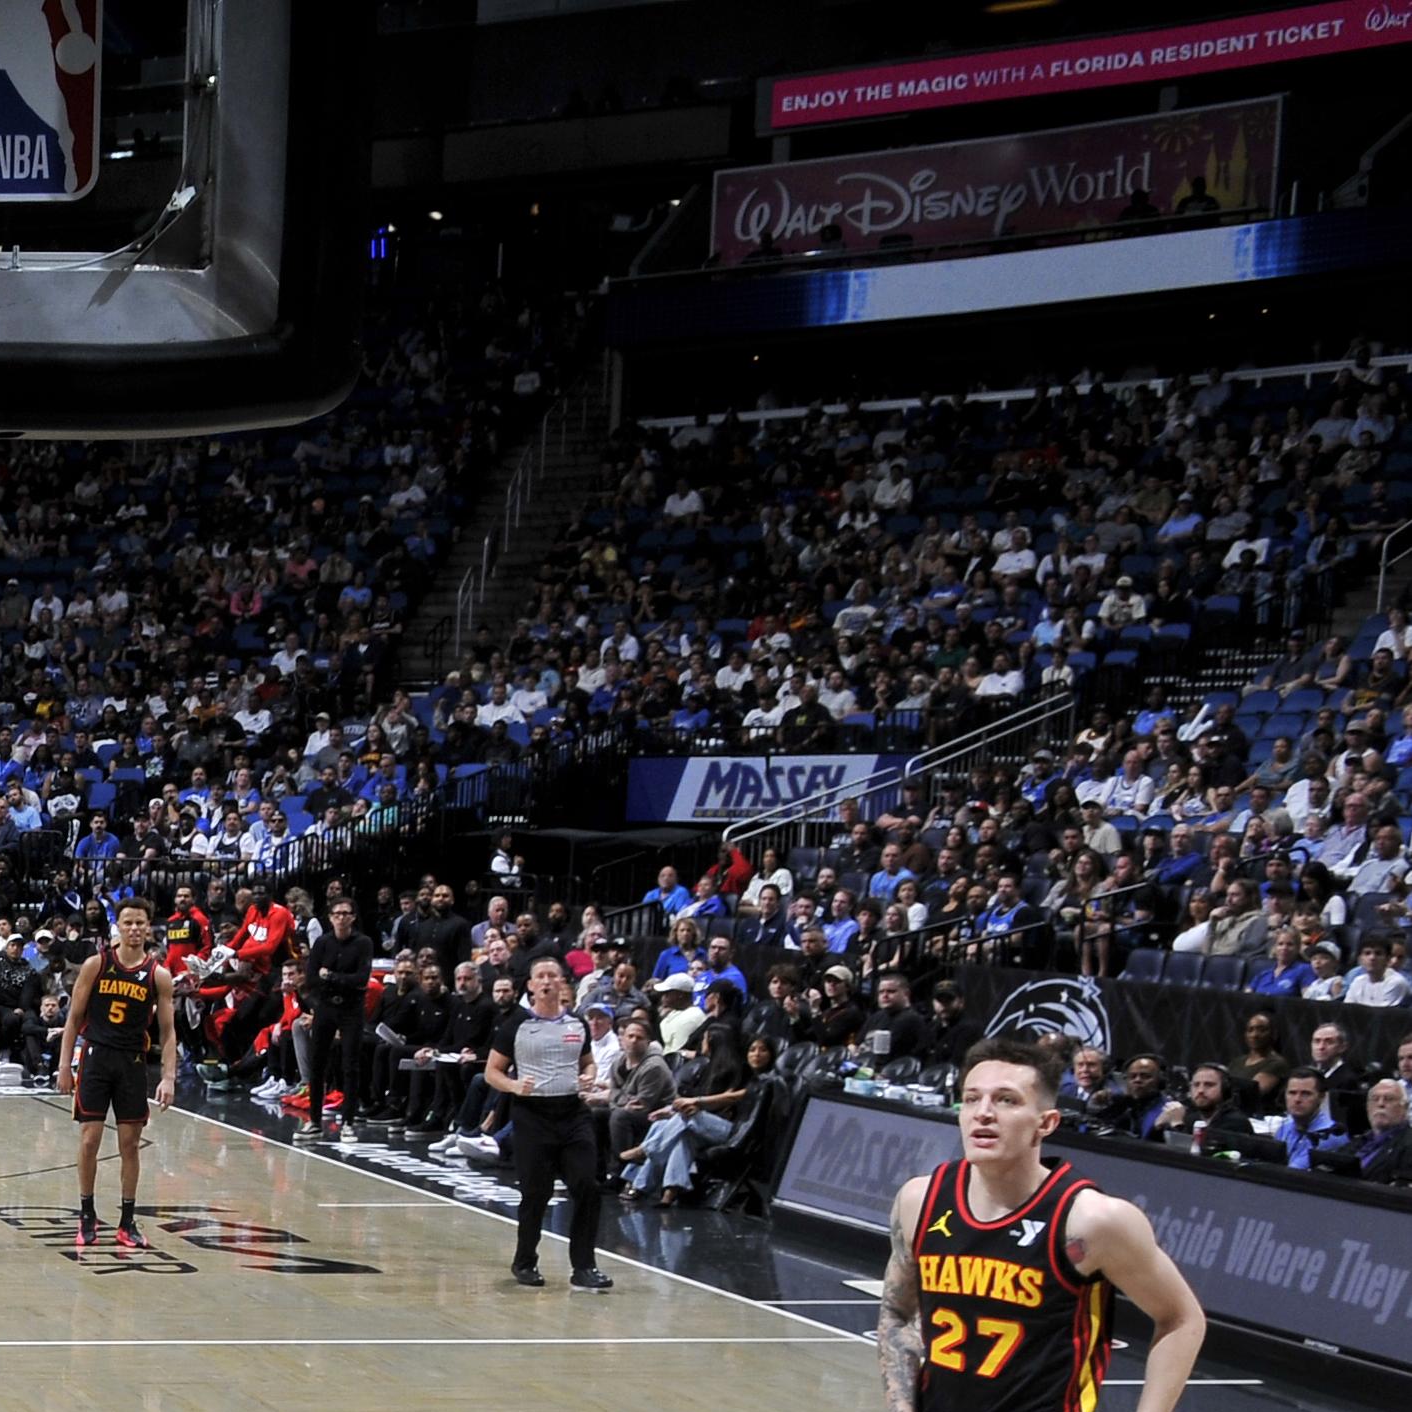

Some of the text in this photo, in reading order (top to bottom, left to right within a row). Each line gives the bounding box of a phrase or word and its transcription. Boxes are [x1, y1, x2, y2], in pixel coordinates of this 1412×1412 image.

[781, 19, 1344, 112] ENJOY THE MAGIC WITH A FLORIDA RESIDENT TICKET
[1029, 151, 1151, 208] World
[695, 761, 846, 808] MASSEY
[99, 979, 147, 1002] HAWKS
[109, 1002, 127, 1024] 5
[919, 1255, 1044, 1307] HAWKS
[1225, 1217, 1325, 1294] Where
[1328, 1239, 1409, 1325] They
[931, 1308, 1024, 1379] 27
